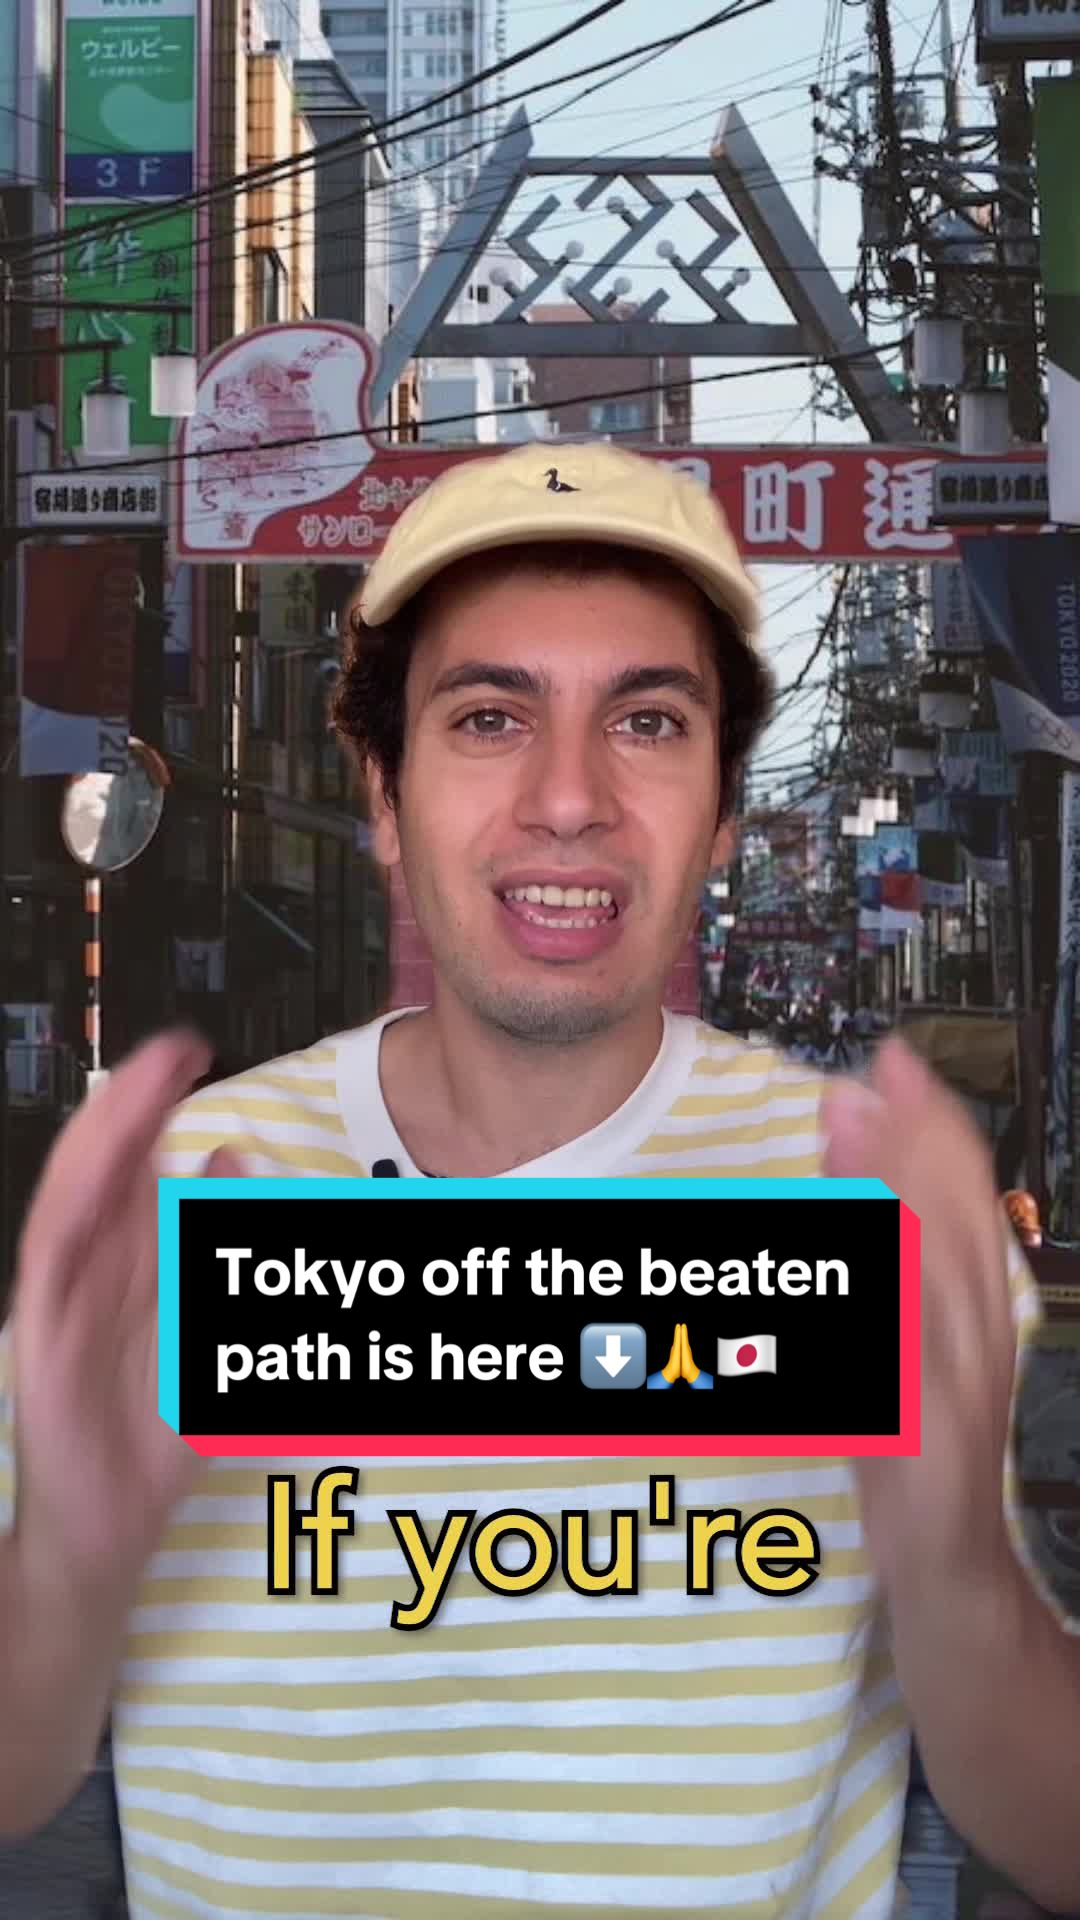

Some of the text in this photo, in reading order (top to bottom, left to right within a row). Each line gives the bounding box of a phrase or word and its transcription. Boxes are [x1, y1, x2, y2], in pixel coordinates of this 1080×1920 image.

[81, 36, 181, 60] ウェルビー
[1057, 583, 1079, 704] TOKYO 2020
